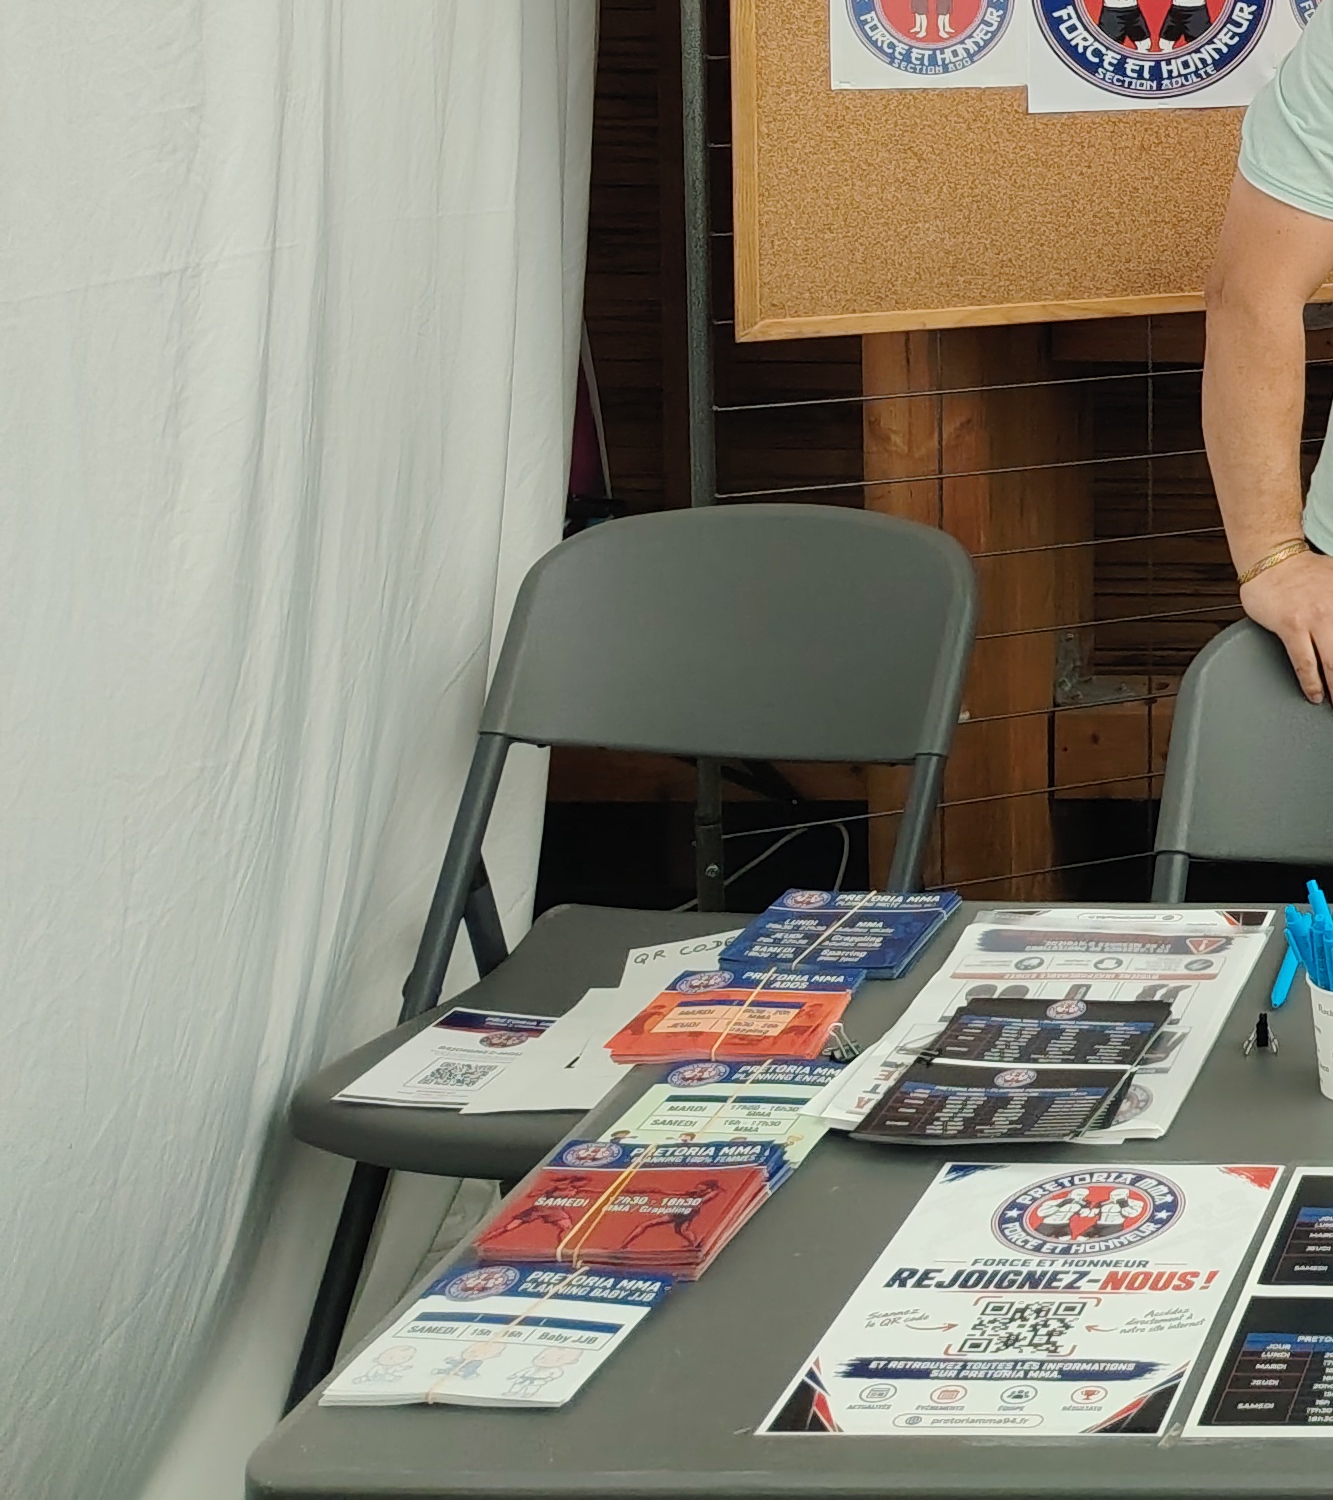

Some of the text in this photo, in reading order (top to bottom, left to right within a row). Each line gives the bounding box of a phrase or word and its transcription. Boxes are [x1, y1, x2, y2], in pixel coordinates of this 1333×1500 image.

[860, 9, 1004, 67] FORCE ET HONNEUR
[1050, 6, 1119, 69] FORCE
[1123, 57, 1156, 81] ET
[1162, 3, 1256, 81] HONNEUR
[892, 57, 972, 75] SECTION ADO
[1096, 64, 1216, 91] SECTION ADULTE
[907, 895, 941, 903] MMA
[784, 918, 817, 926] LUNDI
[634, 949, 666, 966] QR
[811, 975, 844, 983] MMA
[770, 981, 808, 989] ADOS
[718, 1145, 761, 1155] MMA
[1016, 1173, 1174, 1204] PRETORIA MMA
[535, 1196, 590, 1207] SAMEDI
[639, 1205, 692, 1215] Grappling
[1002, 1222, 1161, 1254] FORCE ET HONNEUR
[971, 1258, 1149, 1269] FORCE ET HONNEUR
[616, 1279, 661, 1292] MMA
[407, 1325, 456, 1335] SAMEDI
[538, 1331, 570, 1344] Baby
[870, 1361, 1136, 1372] ET RETROUVEZ TOUTES LES INFORMATIONS
[959, 1370, 1025, 1378] PRETORIA
